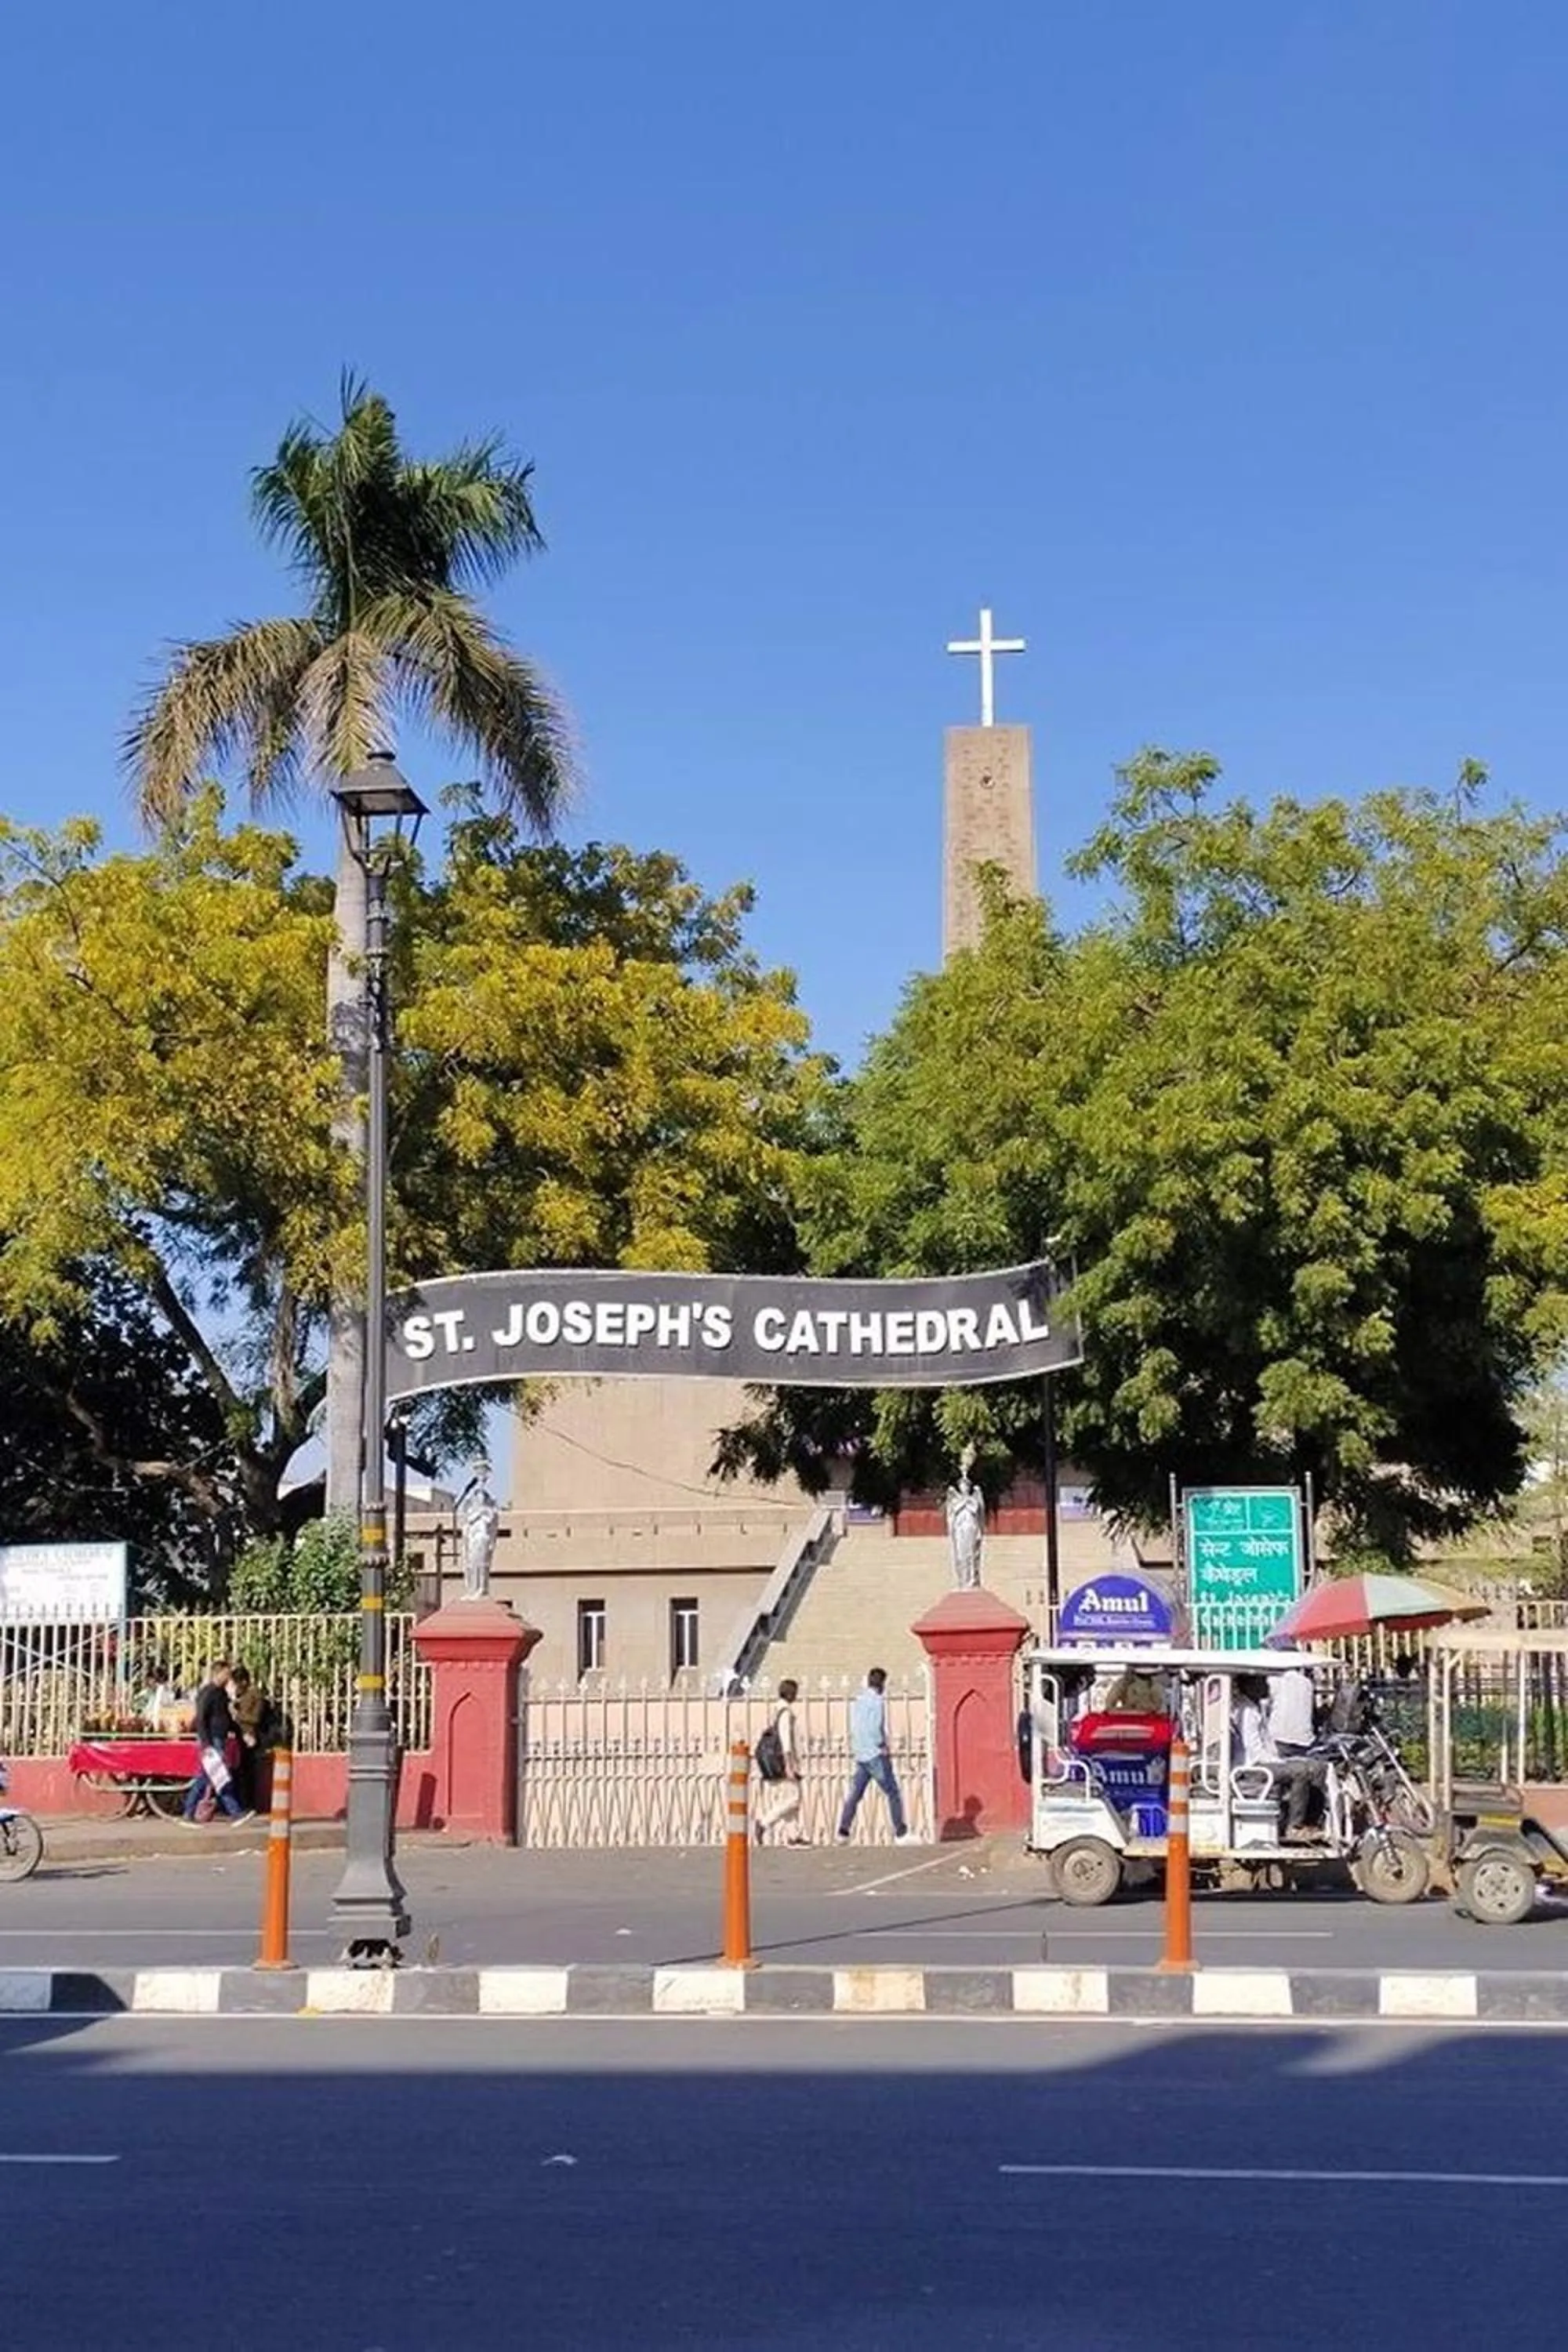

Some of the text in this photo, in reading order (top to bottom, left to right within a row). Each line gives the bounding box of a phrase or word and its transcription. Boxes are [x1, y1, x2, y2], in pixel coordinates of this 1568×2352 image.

[403, 1299, 1050, 1360] ST. JOSEPH'S CATHEDRAL
[1078, 1588, 1149, 1613] Amul
[1091, 1760, 1152, 1785] Amul
